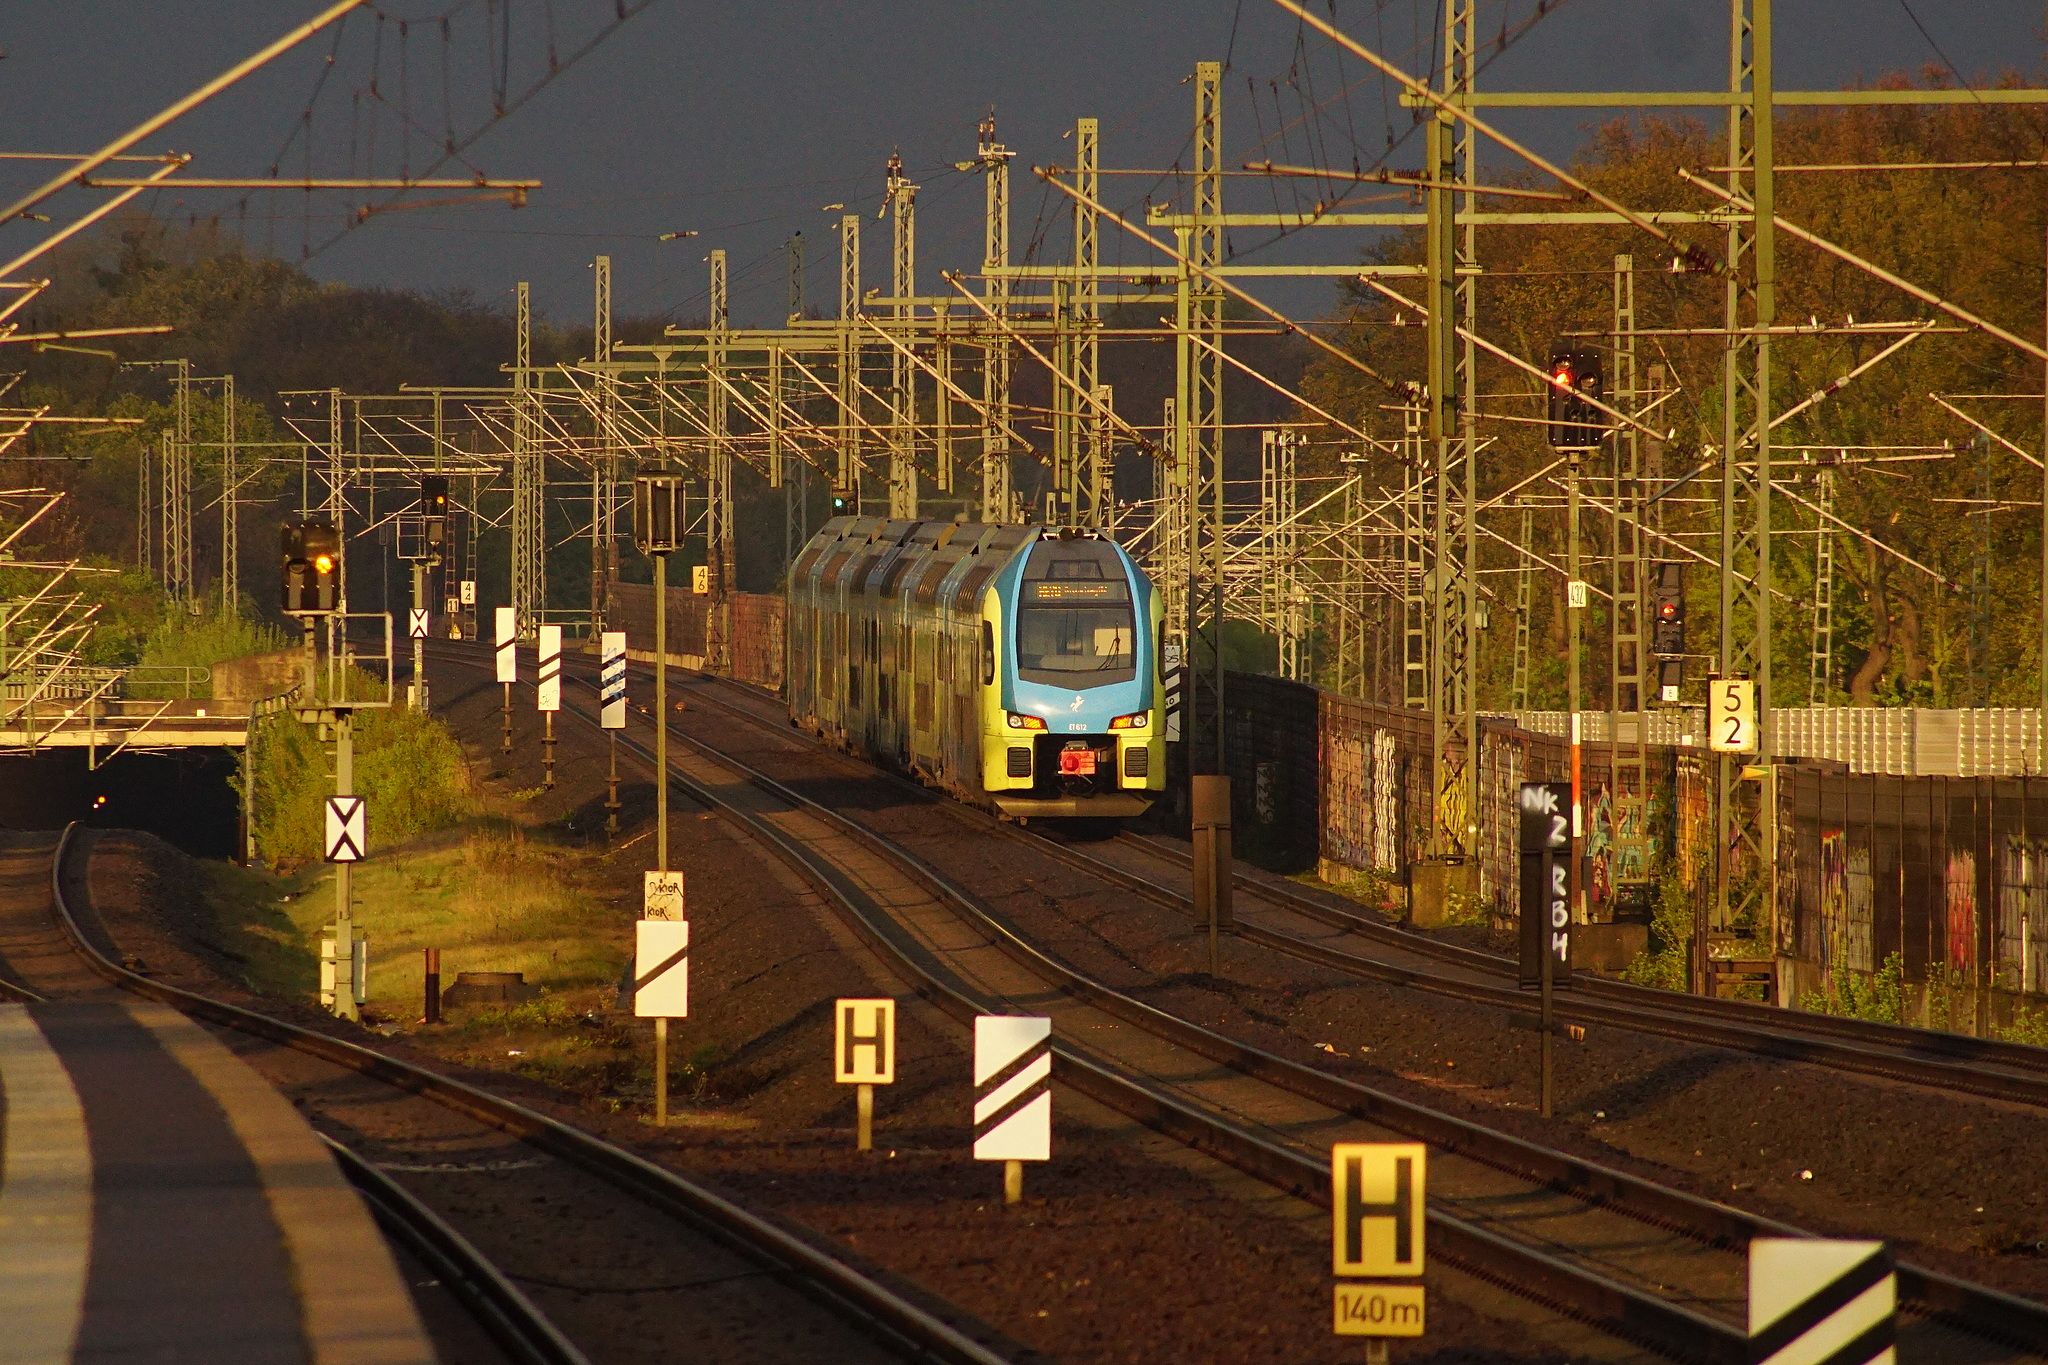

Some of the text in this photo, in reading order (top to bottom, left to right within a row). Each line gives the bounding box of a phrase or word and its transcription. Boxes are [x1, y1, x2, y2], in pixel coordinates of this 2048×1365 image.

[699, 568, 705, 579] 4
[699, 580, 705, 590] 6
[448, 600, 458, 611] 11
[1724, 685, 1741, 712] 5
[1724, 716, 1741, 744] 2
[843, 1007, 886, 1074] H
[1346, 1157, 1412, 1264] H
